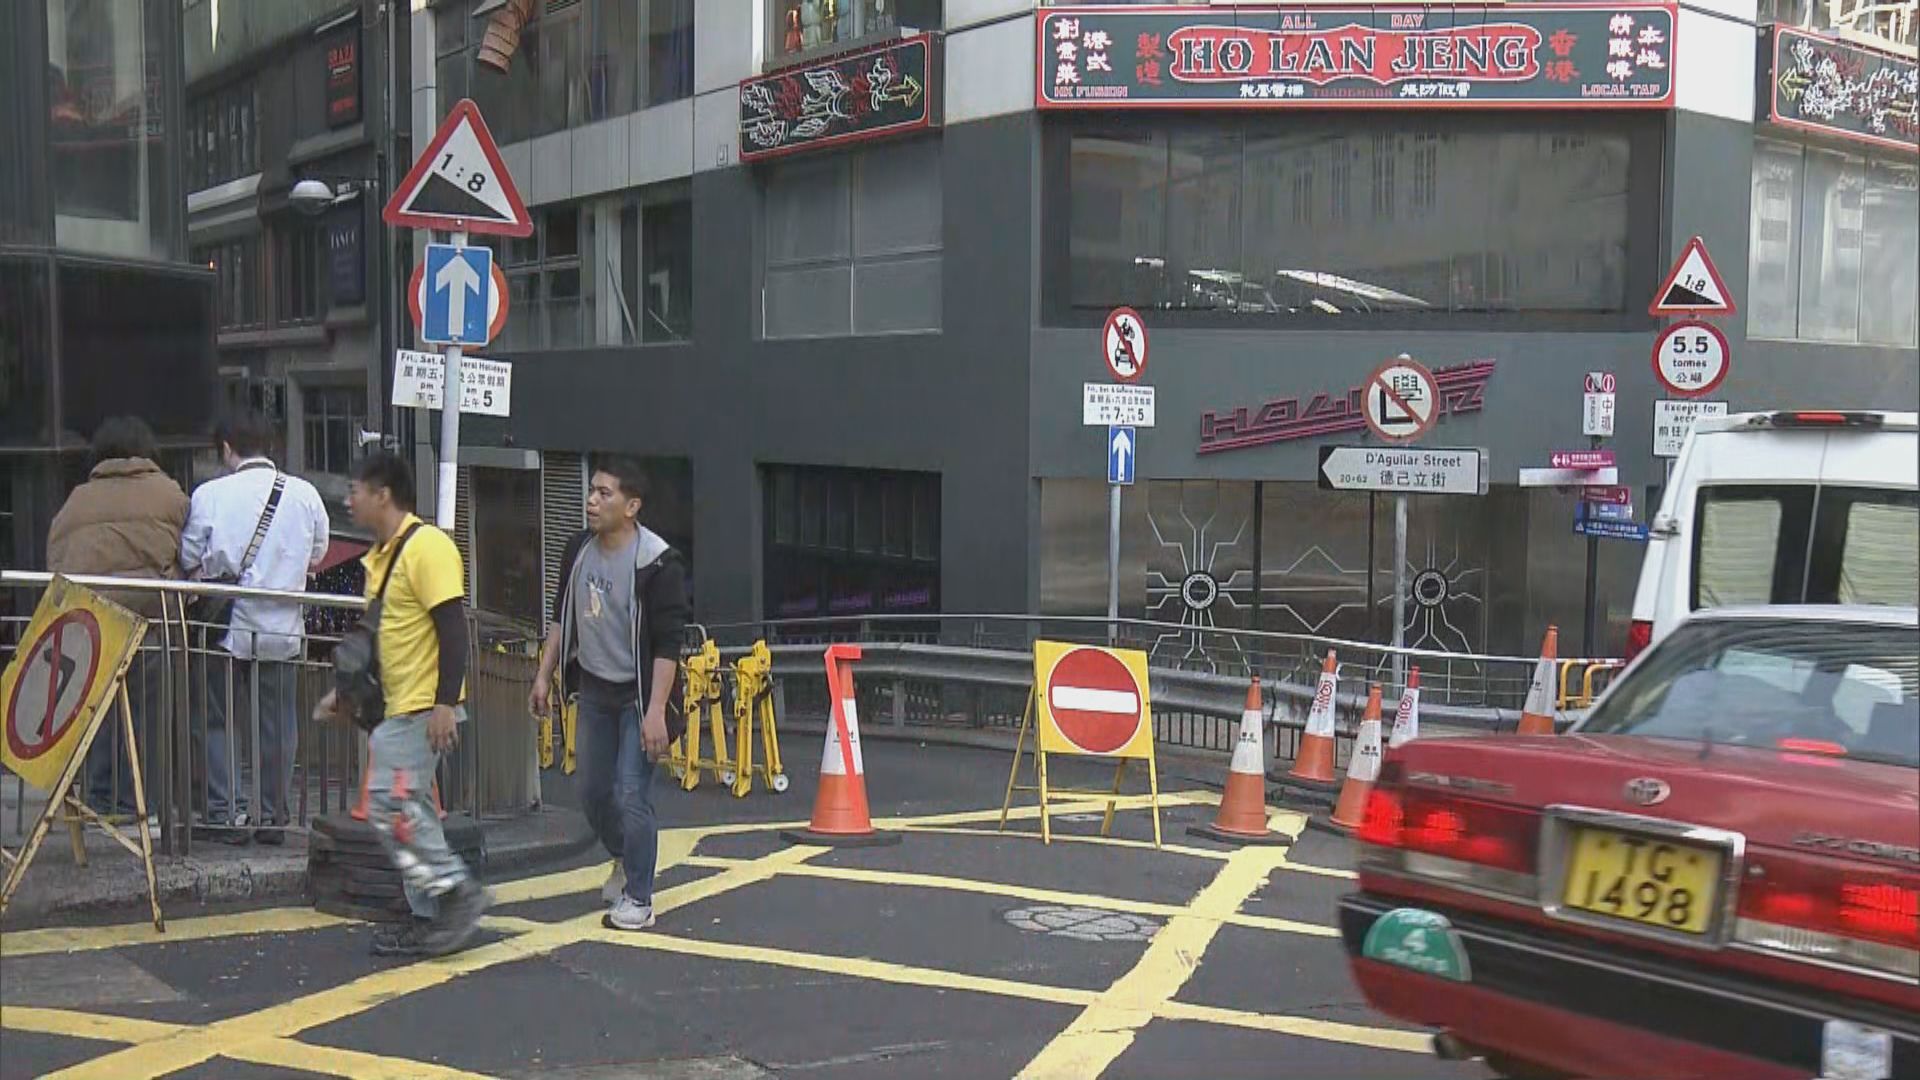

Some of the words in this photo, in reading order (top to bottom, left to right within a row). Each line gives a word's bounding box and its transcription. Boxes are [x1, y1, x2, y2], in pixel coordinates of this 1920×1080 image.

[1281, 15, 1317, 28] ALL
[1391, 14, 1424, 27] DAY
[1179, 37, 1254, 74] HO
[1267, 36, 1377, 73] LAN
[1391, 35, 1528, 73] JENG
[1636, 26, 1665, 68] 本地
[1136, 32, 1164, 85] 製造
[1545, 28, 1580, 84] 香港
[1581, 84, 1629, 96] LOCAL
[1630, 84, 1661, 96] TAP
[441, 153, 486, 193] 1:8
[1685, 274, 1706, 292] 1:8
[1673, 336, 1708, 353] 5.5
[420, 381, 434, 390] pm
[466, 386, 478, 394] am
[416, 392, 436, 404] 下午
[461, 397, 479, 408] 上午
[483, 390, 493, 407] 5
[1380, 388, 1414, 425] L
[1114, 408, 1121, 421] 7
[1137, 407, 1144, 421] 5
[1602, 396, 1613, 432] 中環
[1664, 404, 1698, 415] Except
[1703, 404, 1717, 412] for
[1365, 453, 1419, 467] D'Aguilar
[1423, 454, 1462, 467] Street
[1380, 470, 1447, 487] 德己立街
[1621, 837, 1676, 882] TG
[1583, 870, 1693, 926] 1498
[1402, 928, 1428, 954] 4
